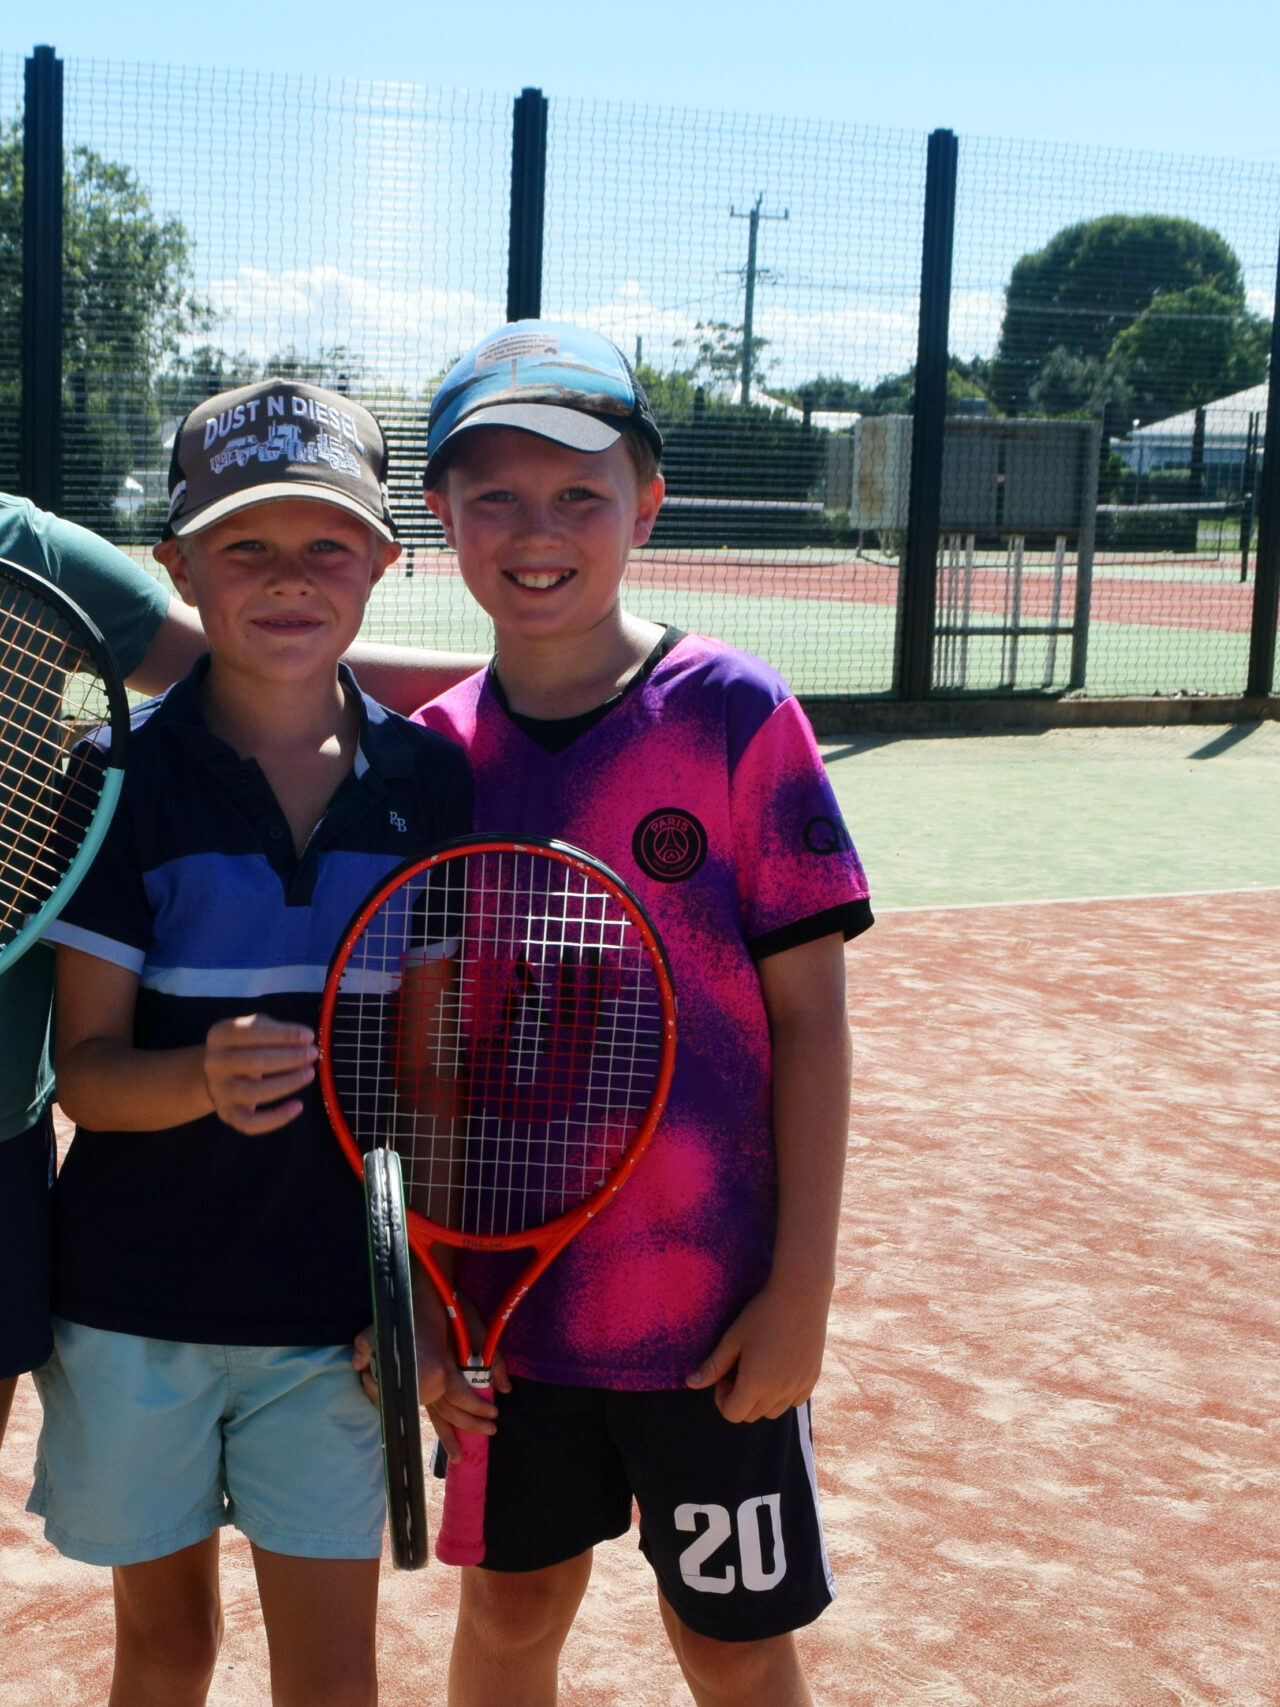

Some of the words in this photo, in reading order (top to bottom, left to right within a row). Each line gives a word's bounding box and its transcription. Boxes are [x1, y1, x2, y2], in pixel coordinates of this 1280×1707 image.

[203, 401, 261, 450] DUST
[267, 396, 285, 416] N
[292, 396, 365, 455] DIESEL
[650, 817, 689, 833] PARIS
[674, 1493, 787, 1594] 20
